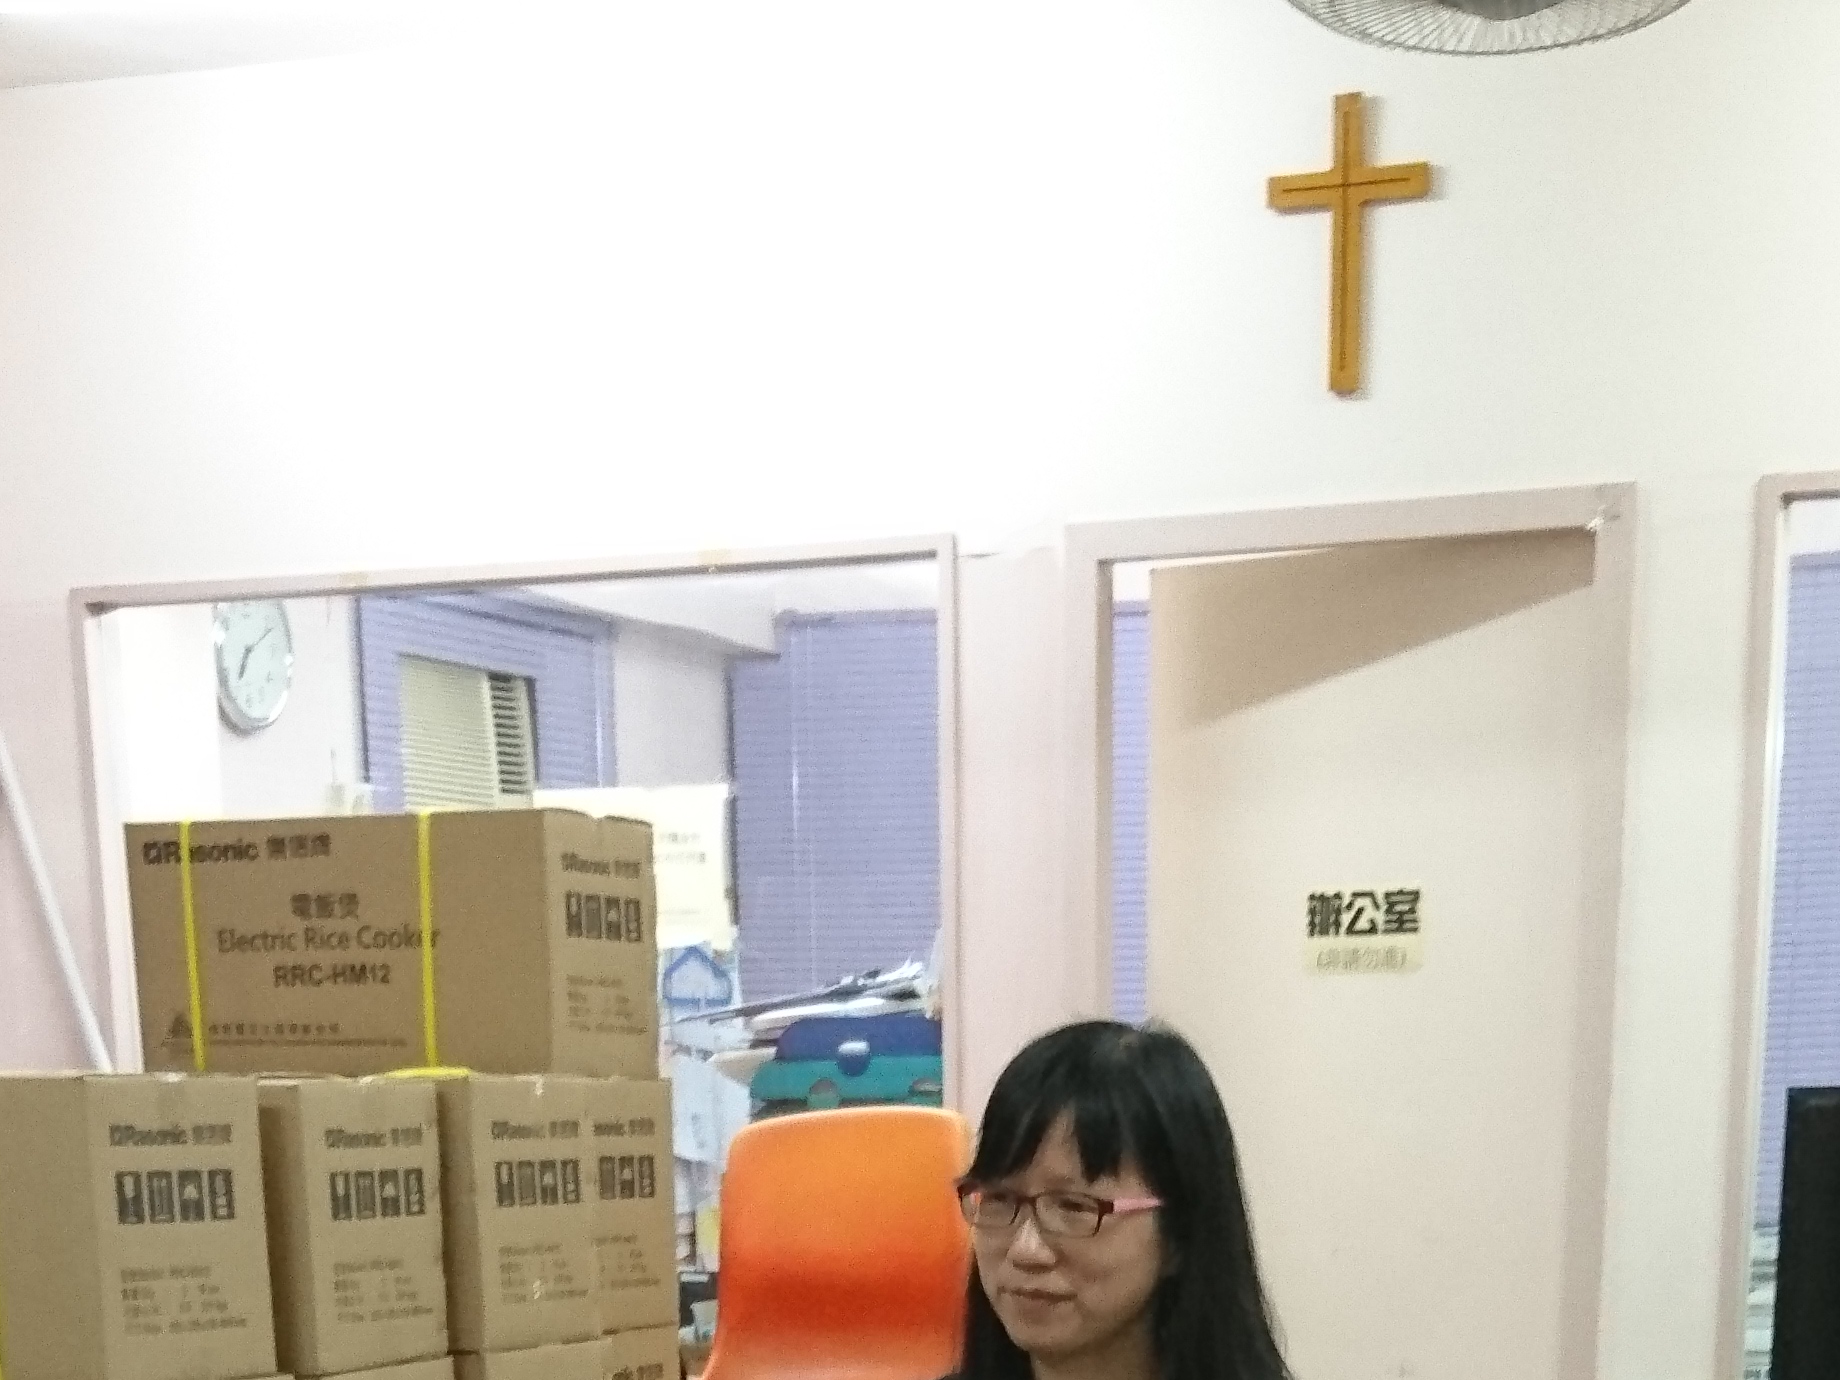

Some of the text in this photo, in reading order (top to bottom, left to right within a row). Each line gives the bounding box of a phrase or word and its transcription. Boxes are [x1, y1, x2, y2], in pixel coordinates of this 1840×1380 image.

[1307, 889, 1421, 938] 辦公室
[218, 923, 440, 952] Electric Rice Cookr
[273, 963, 390, 988] RRC-HM12
